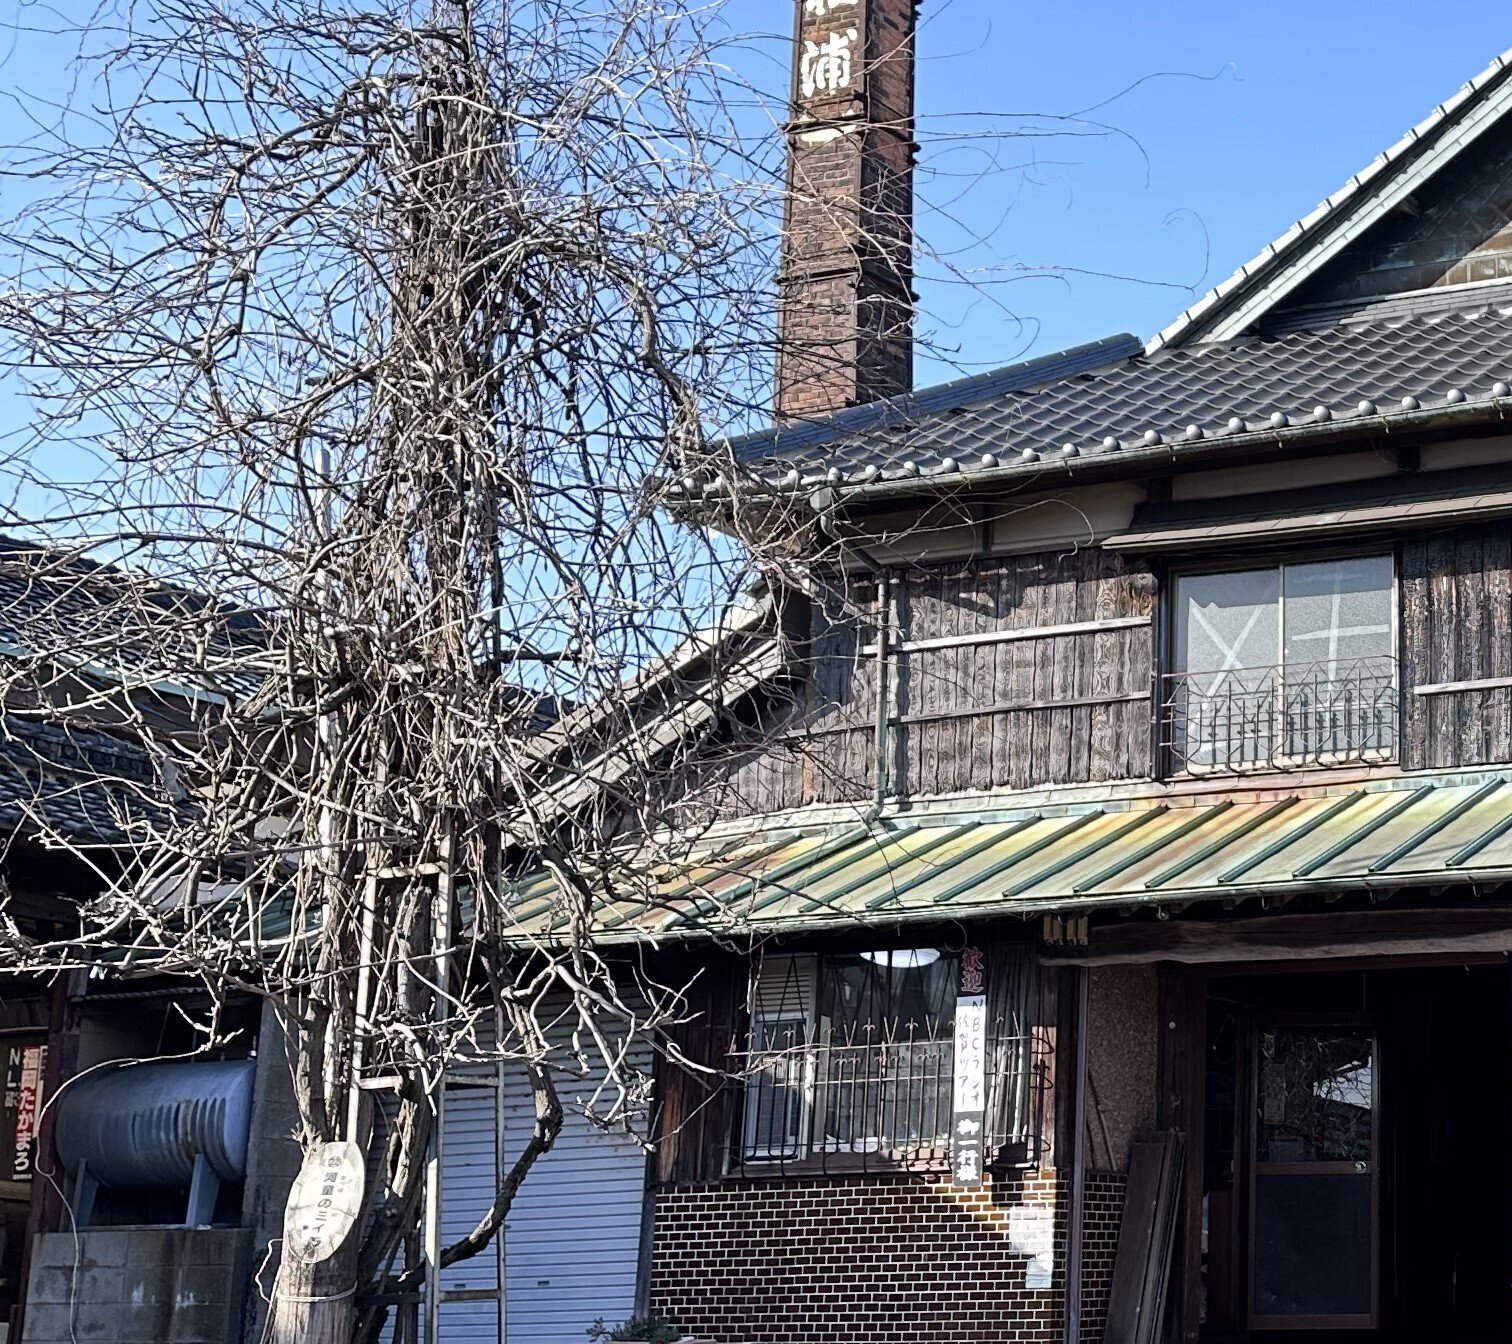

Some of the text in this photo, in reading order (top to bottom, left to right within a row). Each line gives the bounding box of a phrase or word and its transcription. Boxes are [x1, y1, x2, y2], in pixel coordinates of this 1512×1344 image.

[961, 947, 984, 993] 歓迎
[957, 1119, 981, 1182] 御一行様
